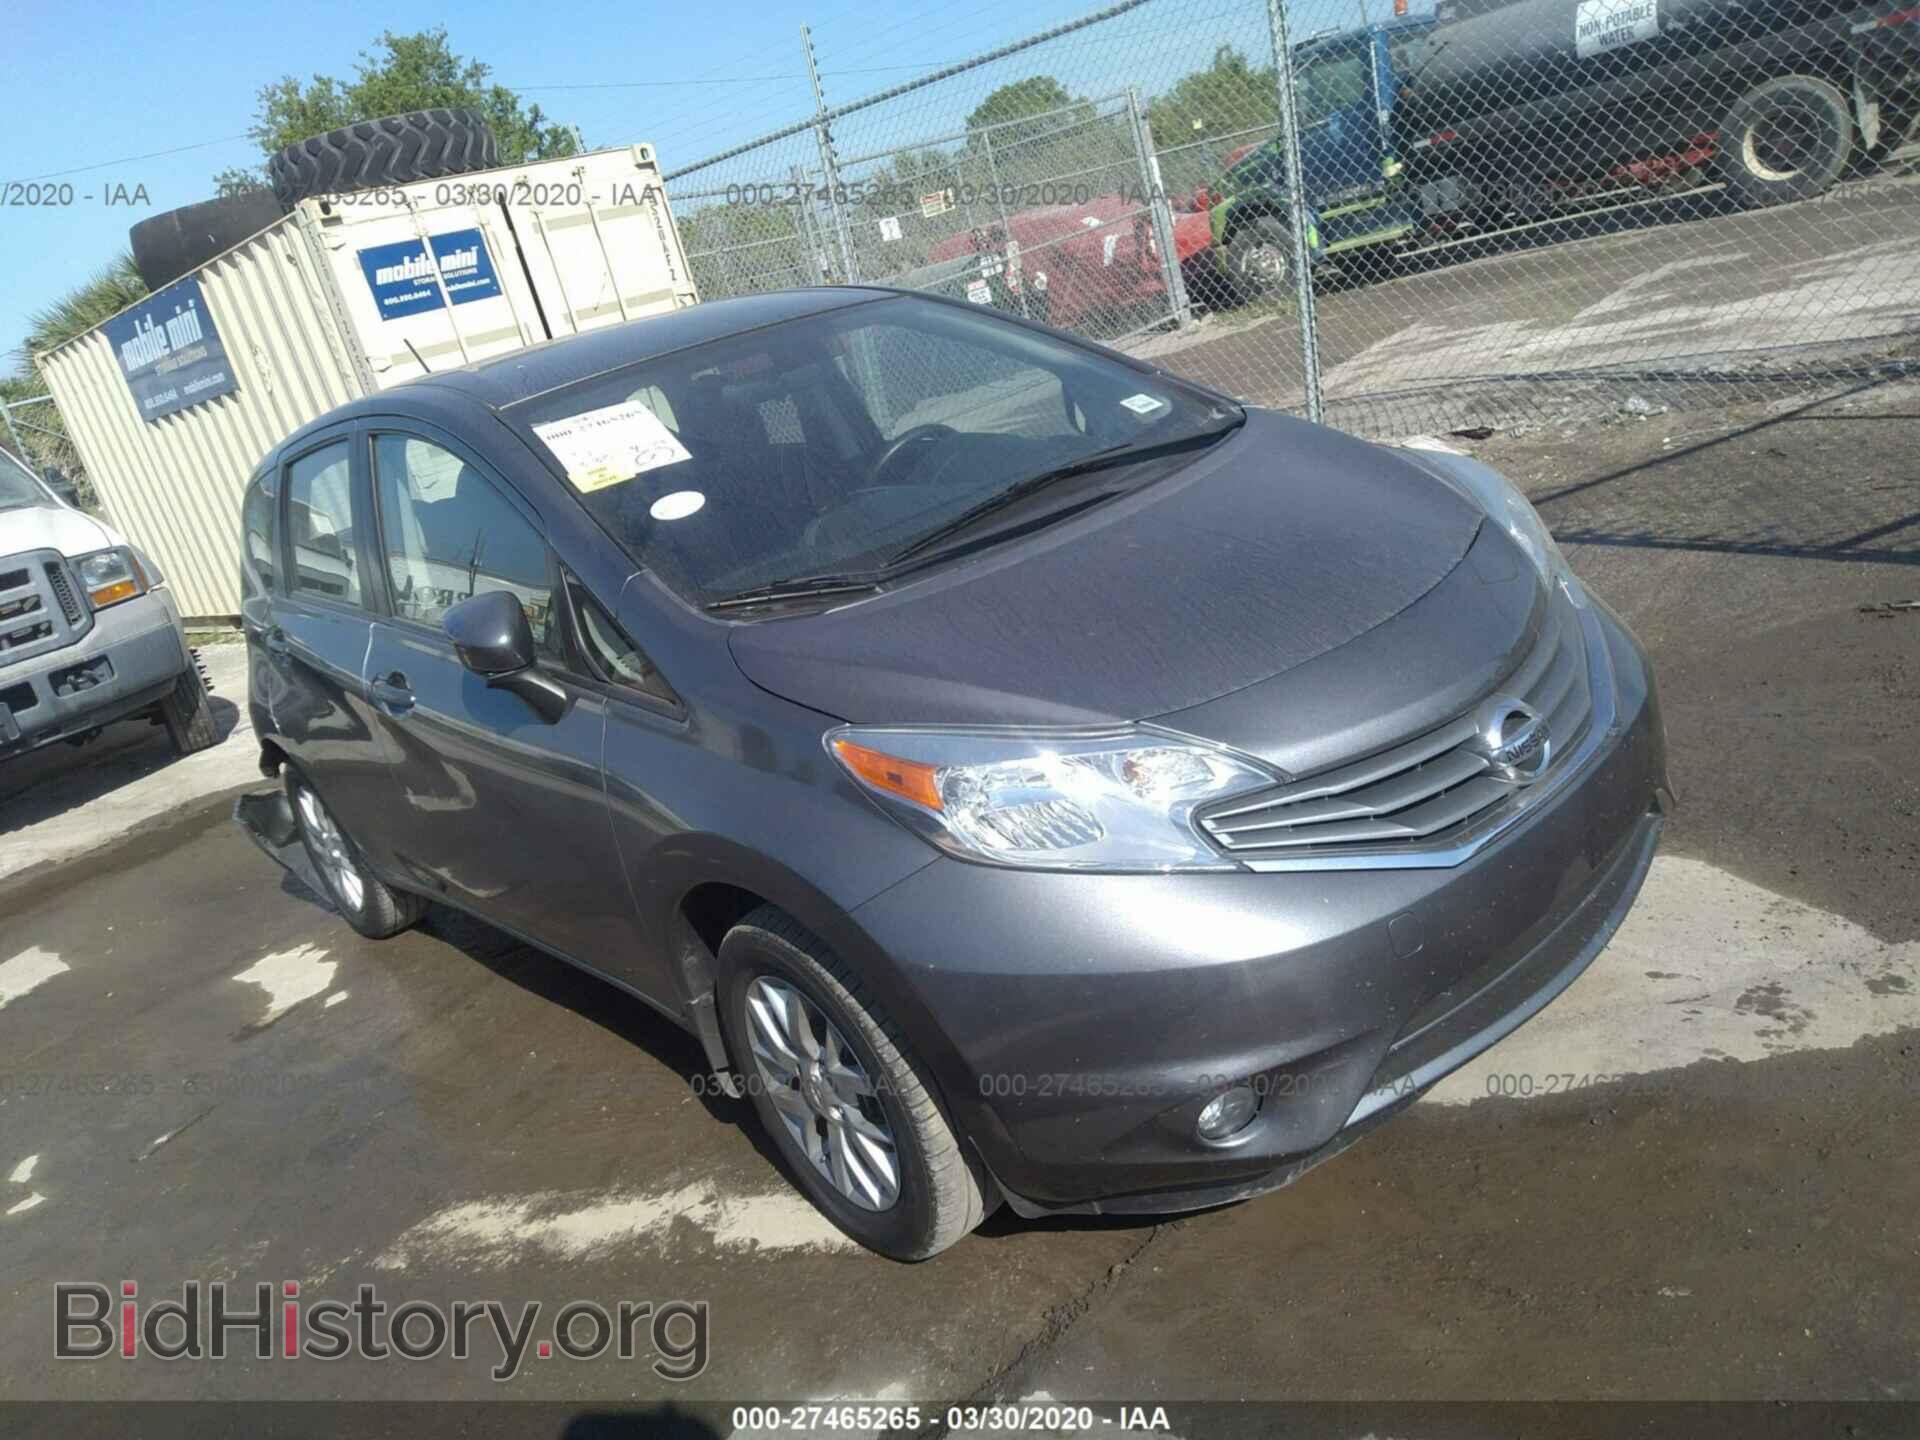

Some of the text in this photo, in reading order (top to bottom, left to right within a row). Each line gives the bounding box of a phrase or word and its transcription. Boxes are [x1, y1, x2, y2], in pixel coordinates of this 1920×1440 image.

[375, 246, 478, 286] mobile mini
[121, 312, 170, 372] mobile
[165, 299, 203, 351] mini
